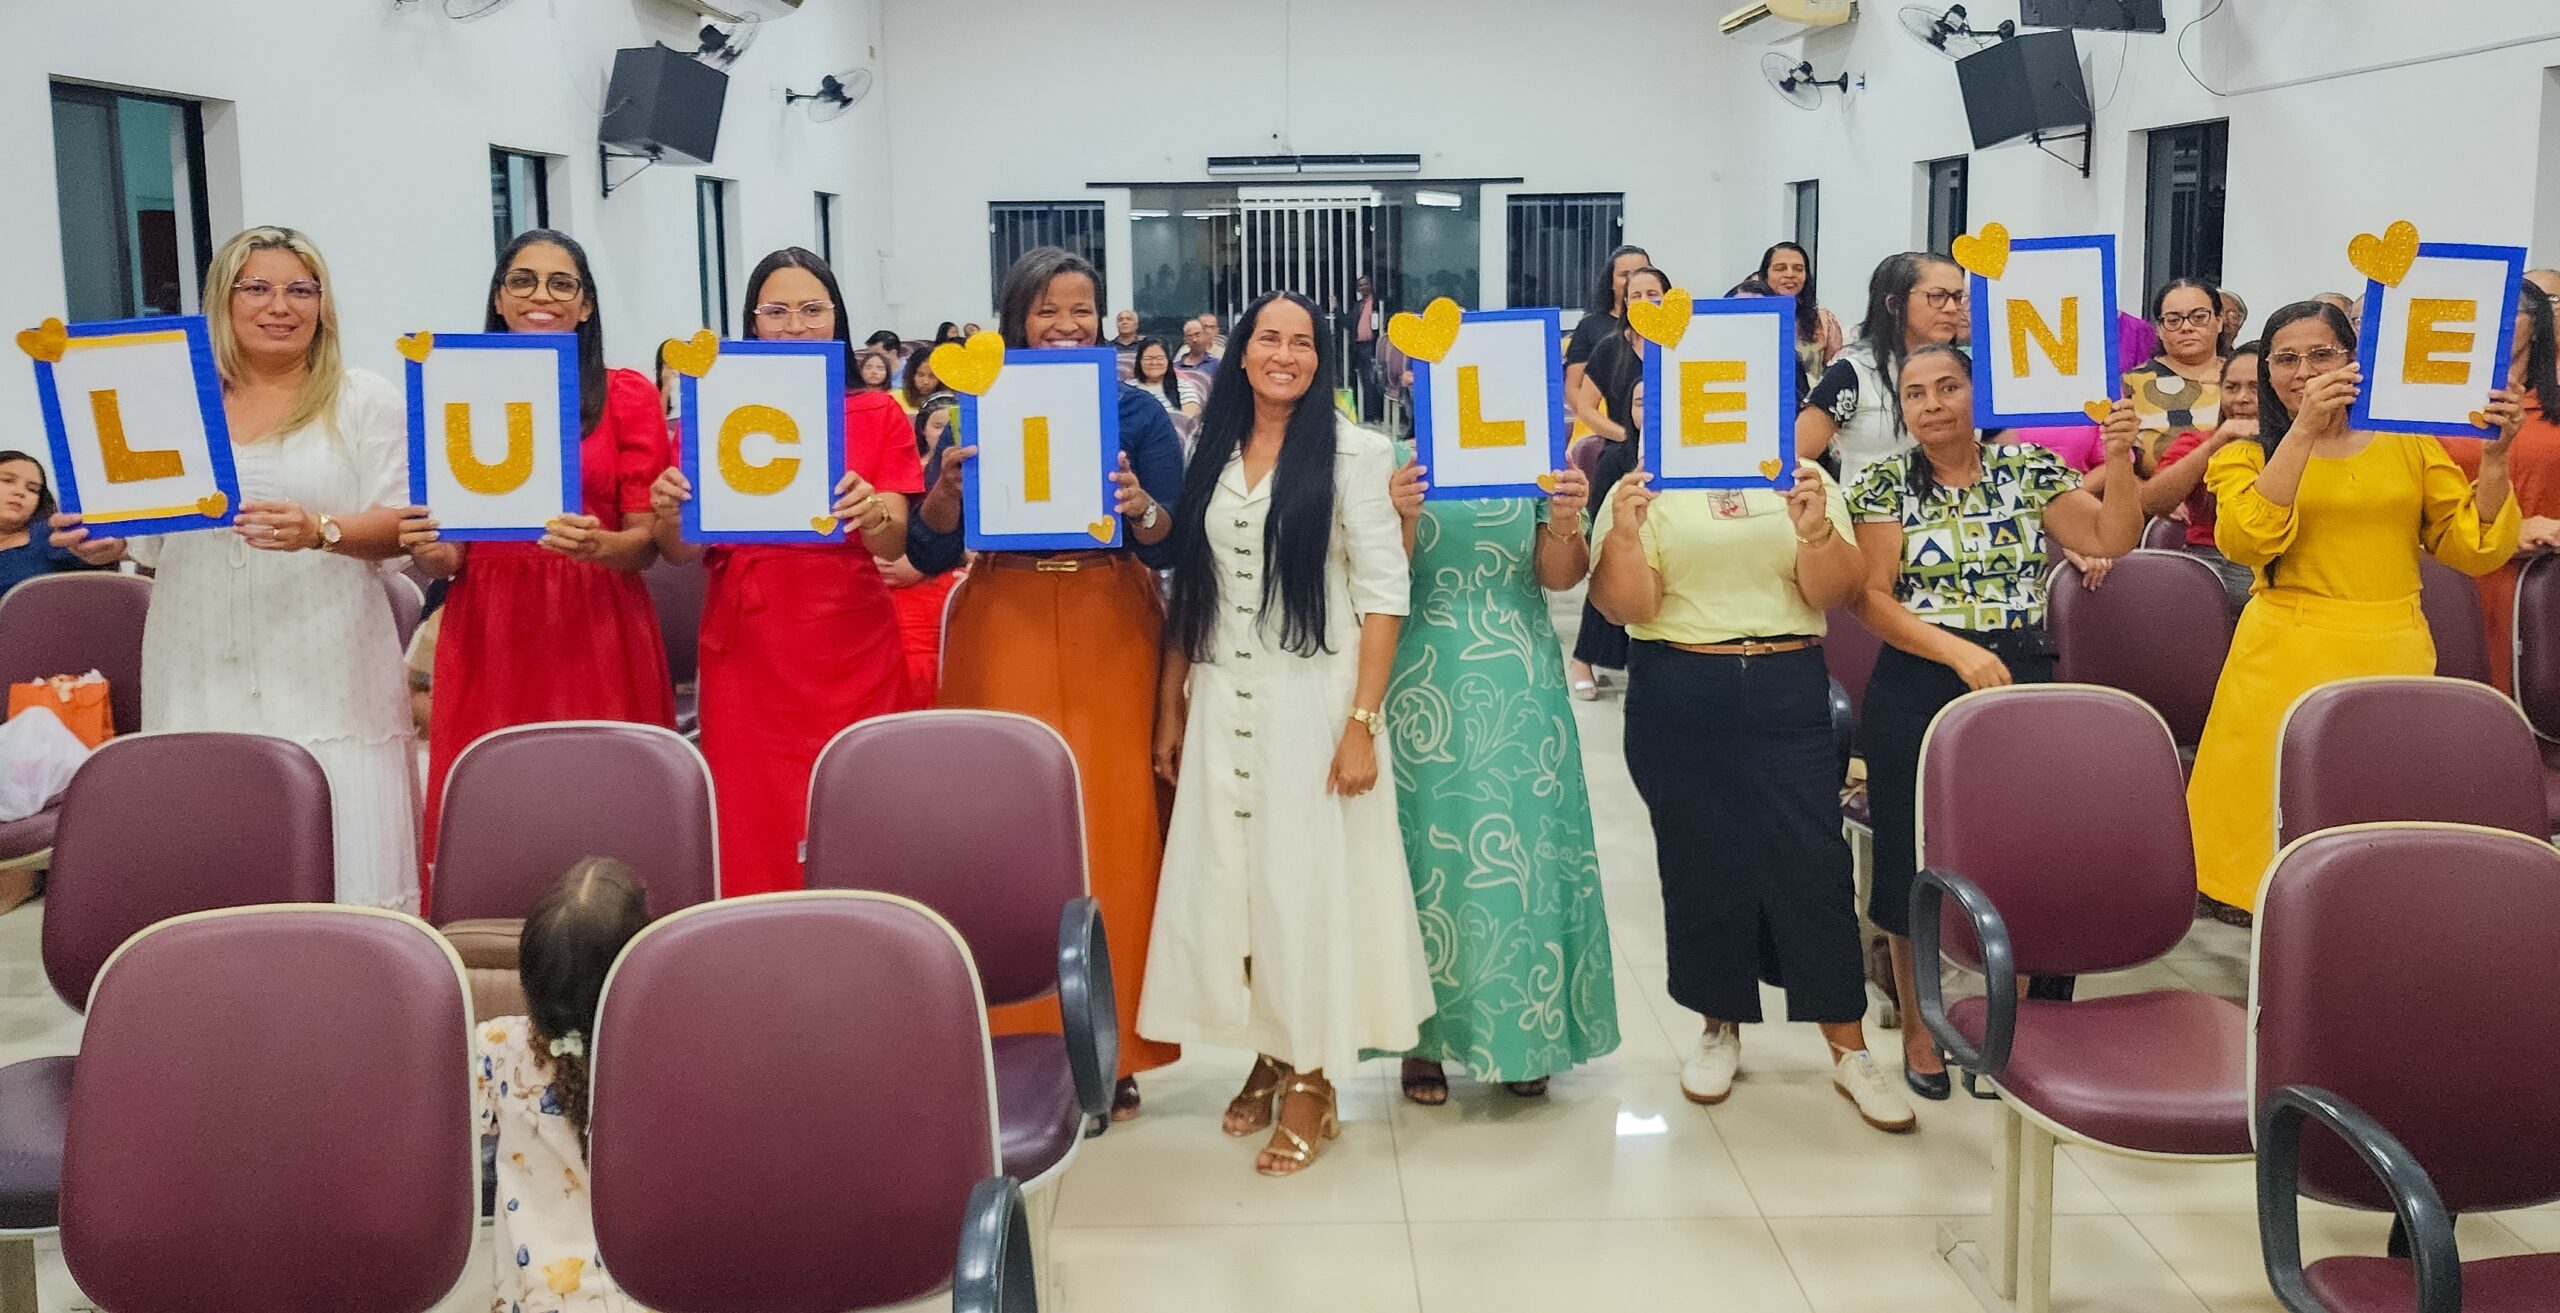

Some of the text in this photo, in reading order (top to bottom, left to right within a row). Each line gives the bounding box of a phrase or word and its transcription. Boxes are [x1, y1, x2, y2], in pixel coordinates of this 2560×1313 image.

[2007, 297, 2079, 377] N
[2402, 298, 2477, 385] E
[90, 390, 184, 483] L
[1458, 366, 1526, 448] L
[1680, 360, 1748, 446] E
[446, 401, 534, 495] U
[718, 404, 801, 495] C
[1023, 416, 1051, 502] I
